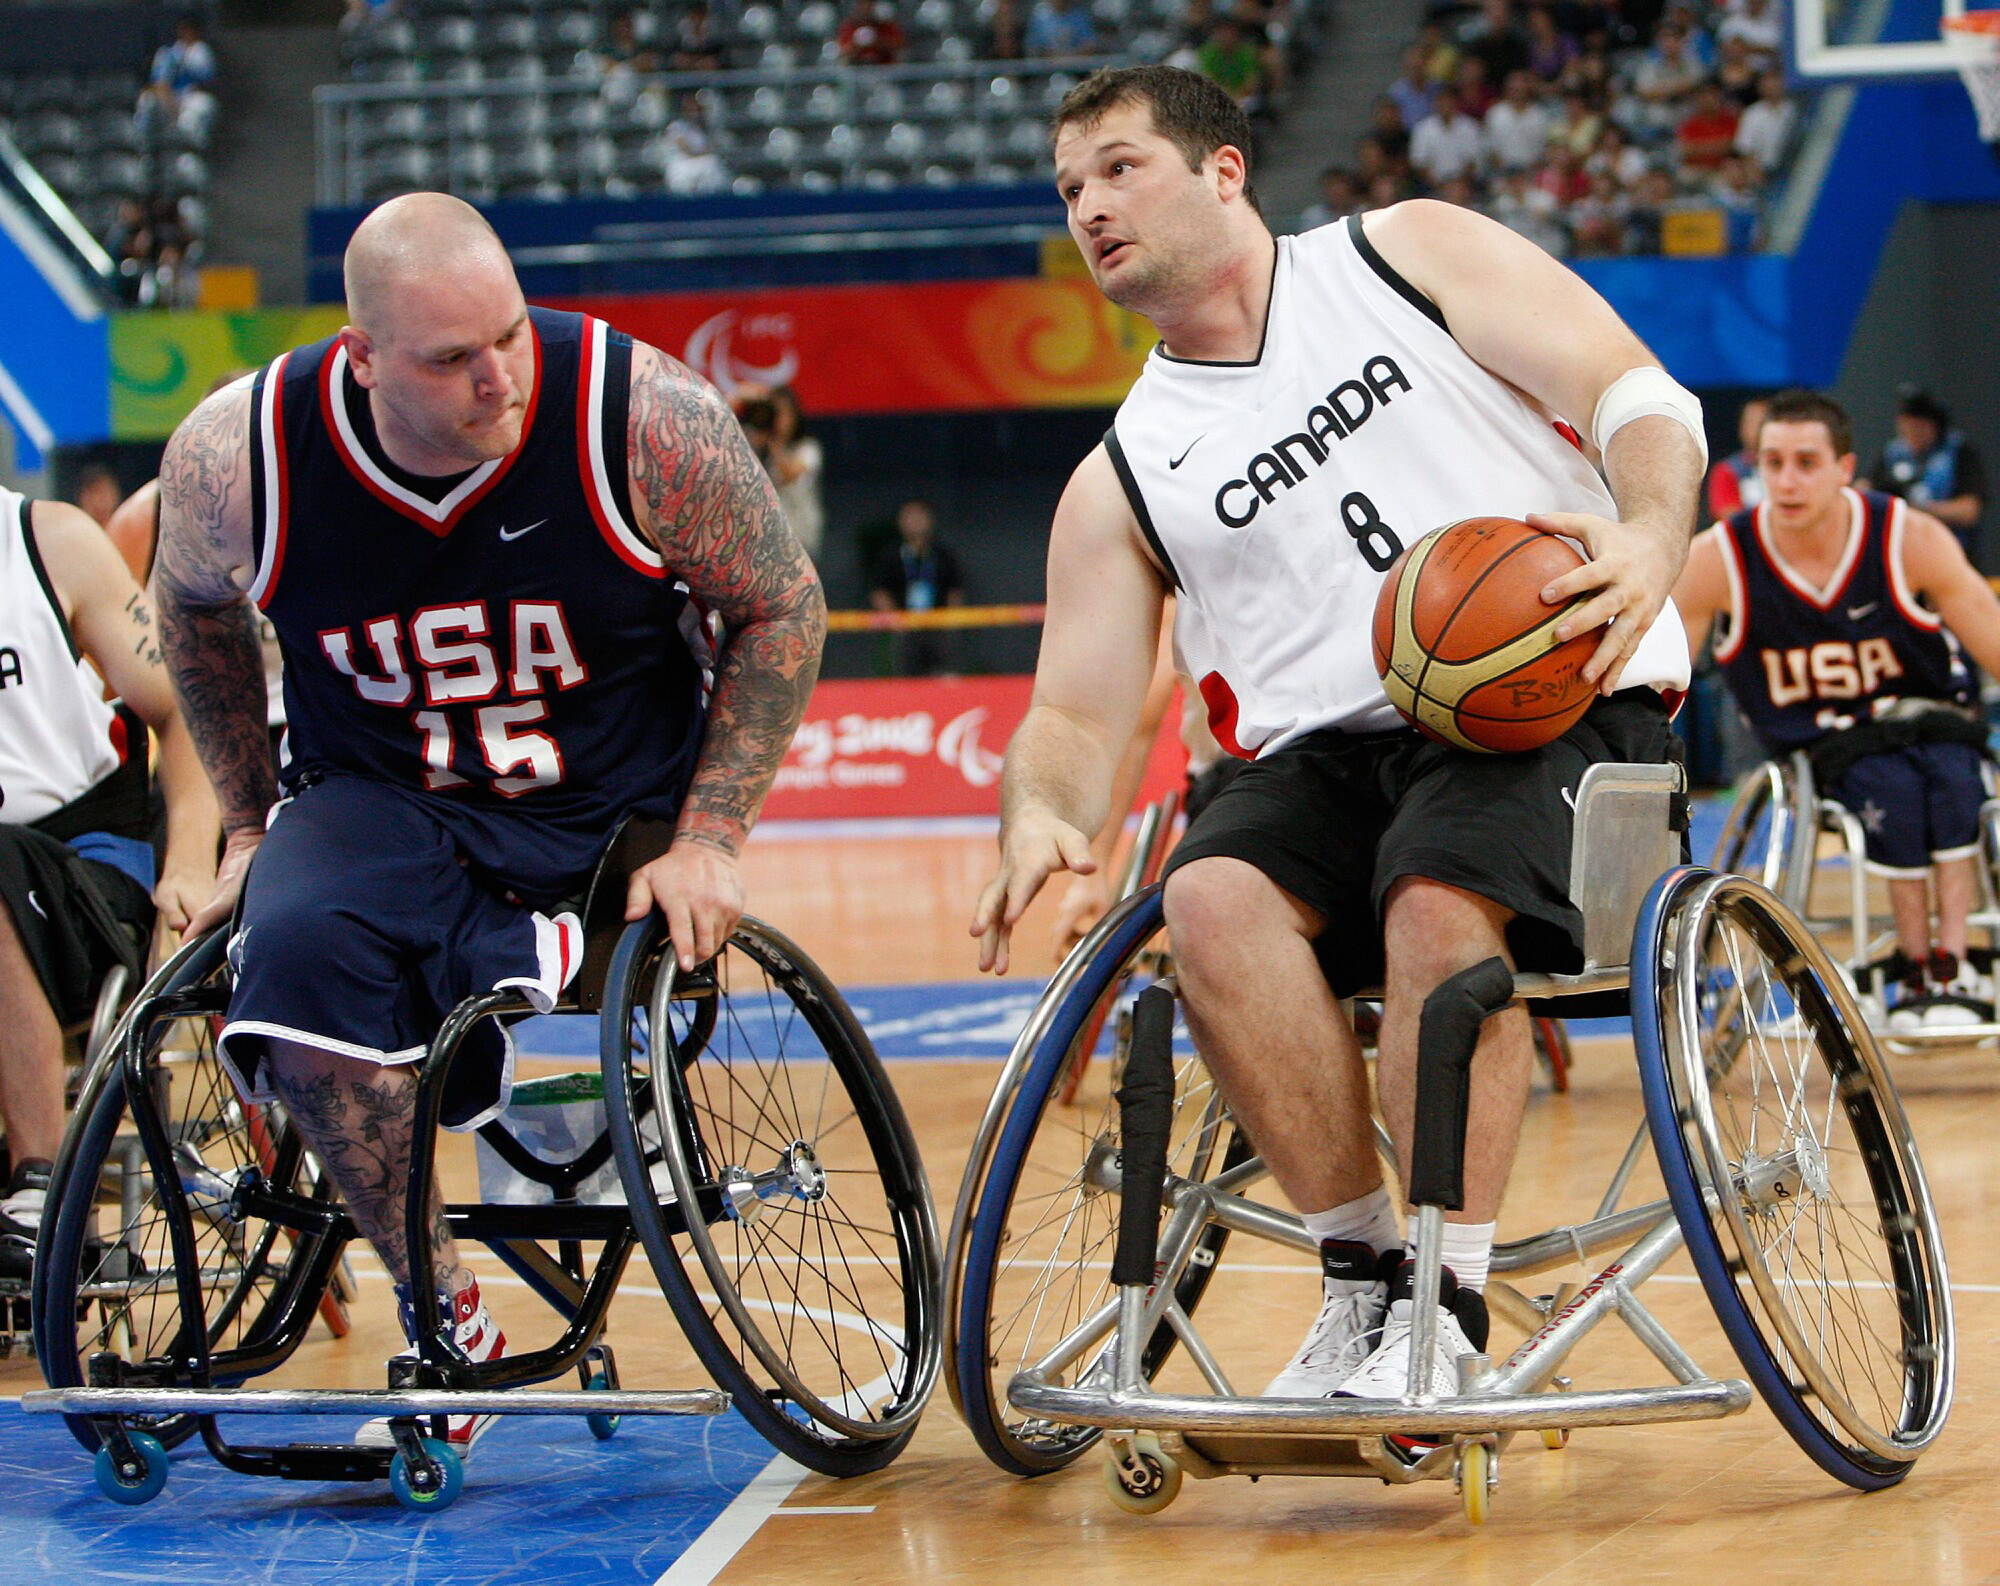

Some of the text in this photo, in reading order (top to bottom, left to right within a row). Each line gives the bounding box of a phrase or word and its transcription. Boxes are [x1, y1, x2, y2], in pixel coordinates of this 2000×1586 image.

[1215, 355, 1413, 528] CANADA
[1340, 491, 1405, 573] 8
[317, 600, 590, 707] USA
[1760, 637, 1904, 708] USA
[410, 700, 566, 799] 15
